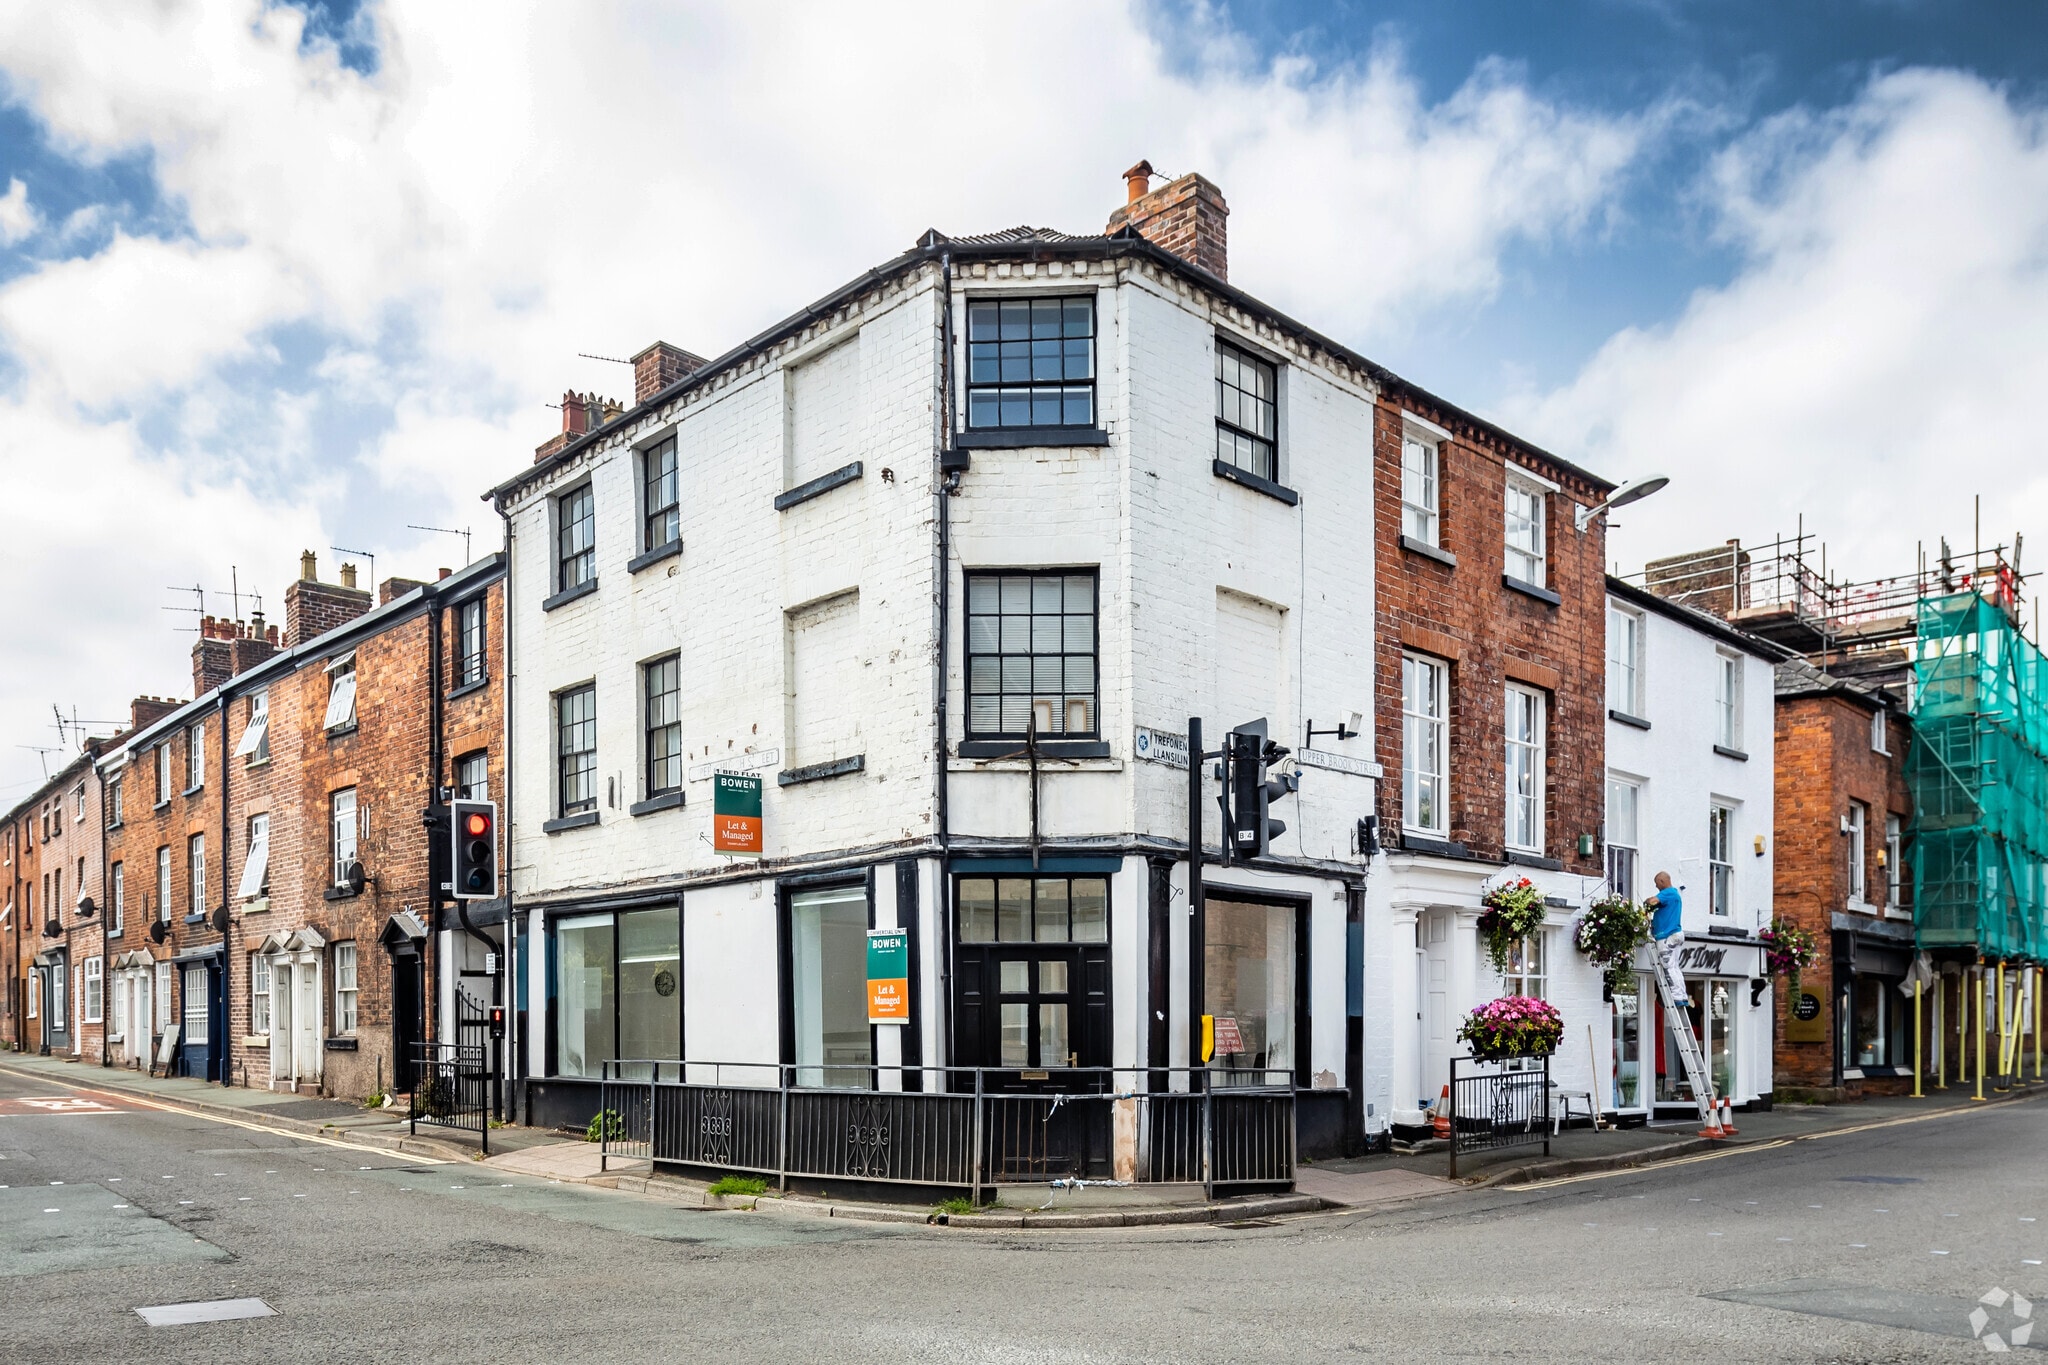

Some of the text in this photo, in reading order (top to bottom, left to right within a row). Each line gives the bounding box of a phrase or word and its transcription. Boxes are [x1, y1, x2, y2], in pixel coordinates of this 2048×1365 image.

[1154, 734, 1188, 752] TREFONEN
[1153, 748, 1189, 765] LLANSILIN
[1302, 750, 1381, 776] UPPER BROOK STREET
[722, 769, 739, 777] BED
[721, 777, 756, 789] BOWEN
[727, 820, 748, 831] Let &
[722, 829, 754, 842] Managed
[872, 938, 901, 949] BOWEN
[878, 984, 895, 995] Let &
[874, 995, 901, 1007] Managed
